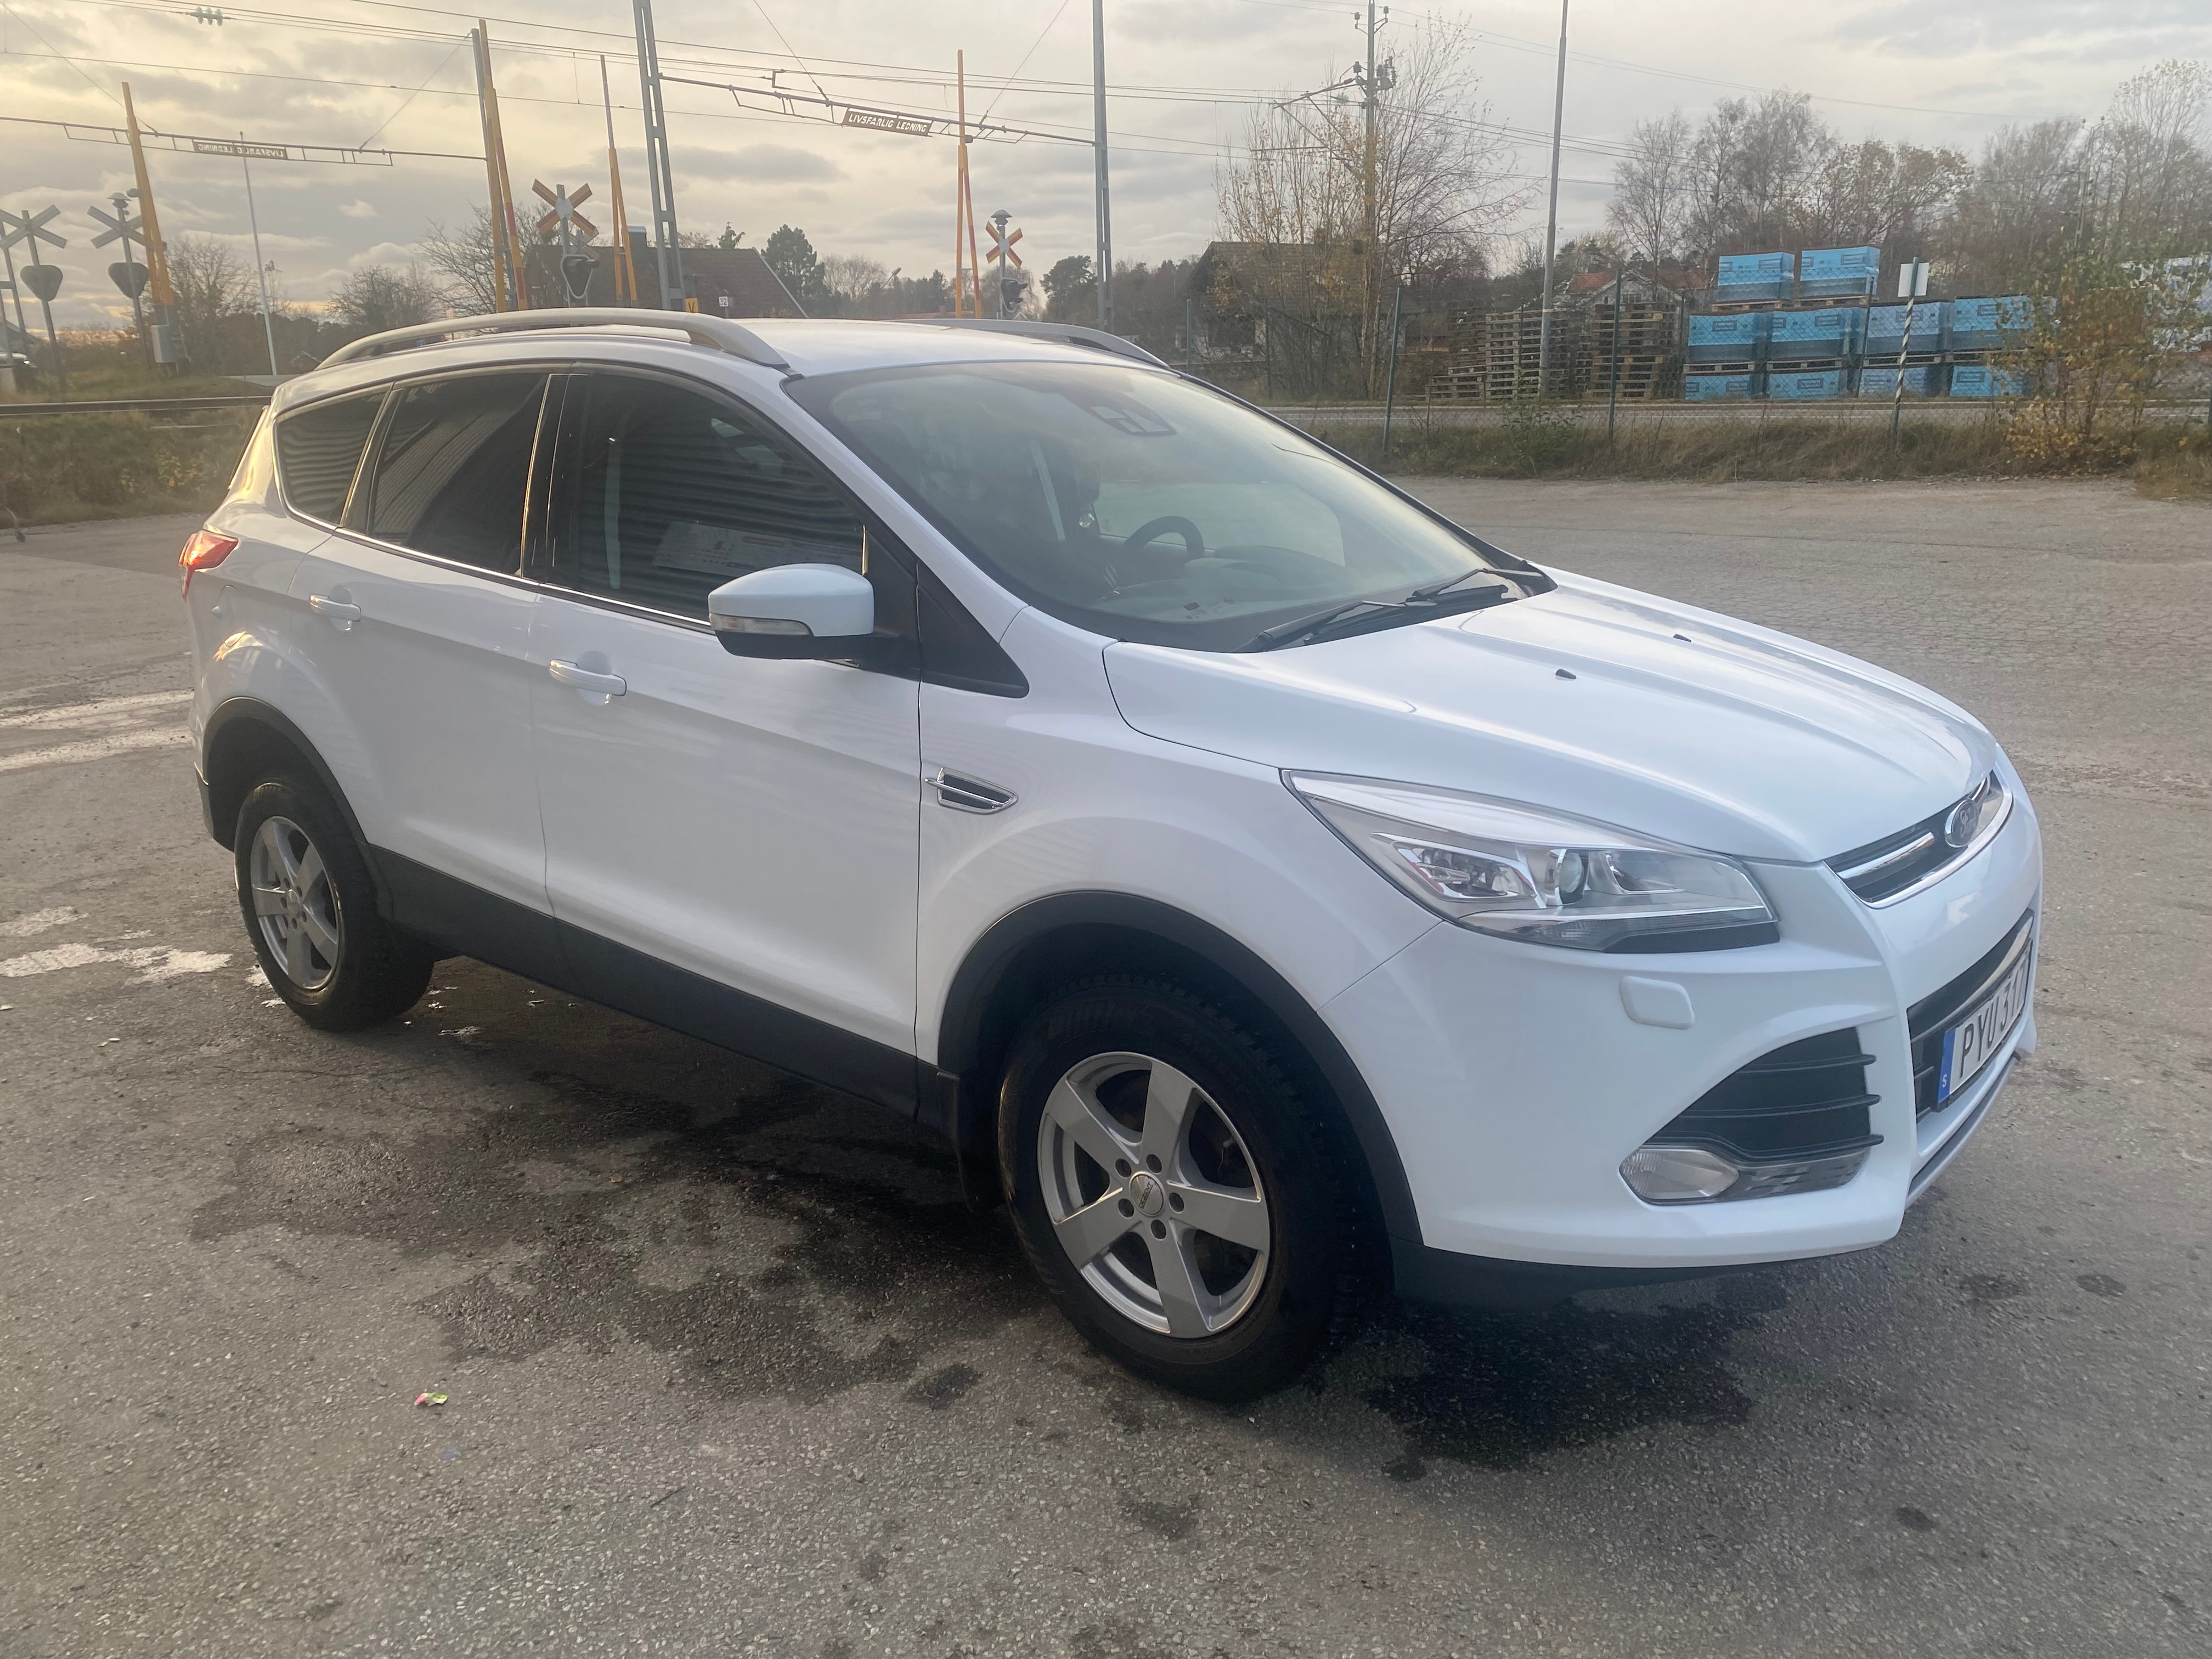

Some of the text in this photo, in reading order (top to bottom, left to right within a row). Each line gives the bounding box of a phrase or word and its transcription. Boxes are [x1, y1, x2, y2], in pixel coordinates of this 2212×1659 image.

[848, 114, 927, 133] LIVSFARLIG LEDNING
[1960, 996, 1999, 1079] PYU
[1942, 1074, 1948, 1088] S
